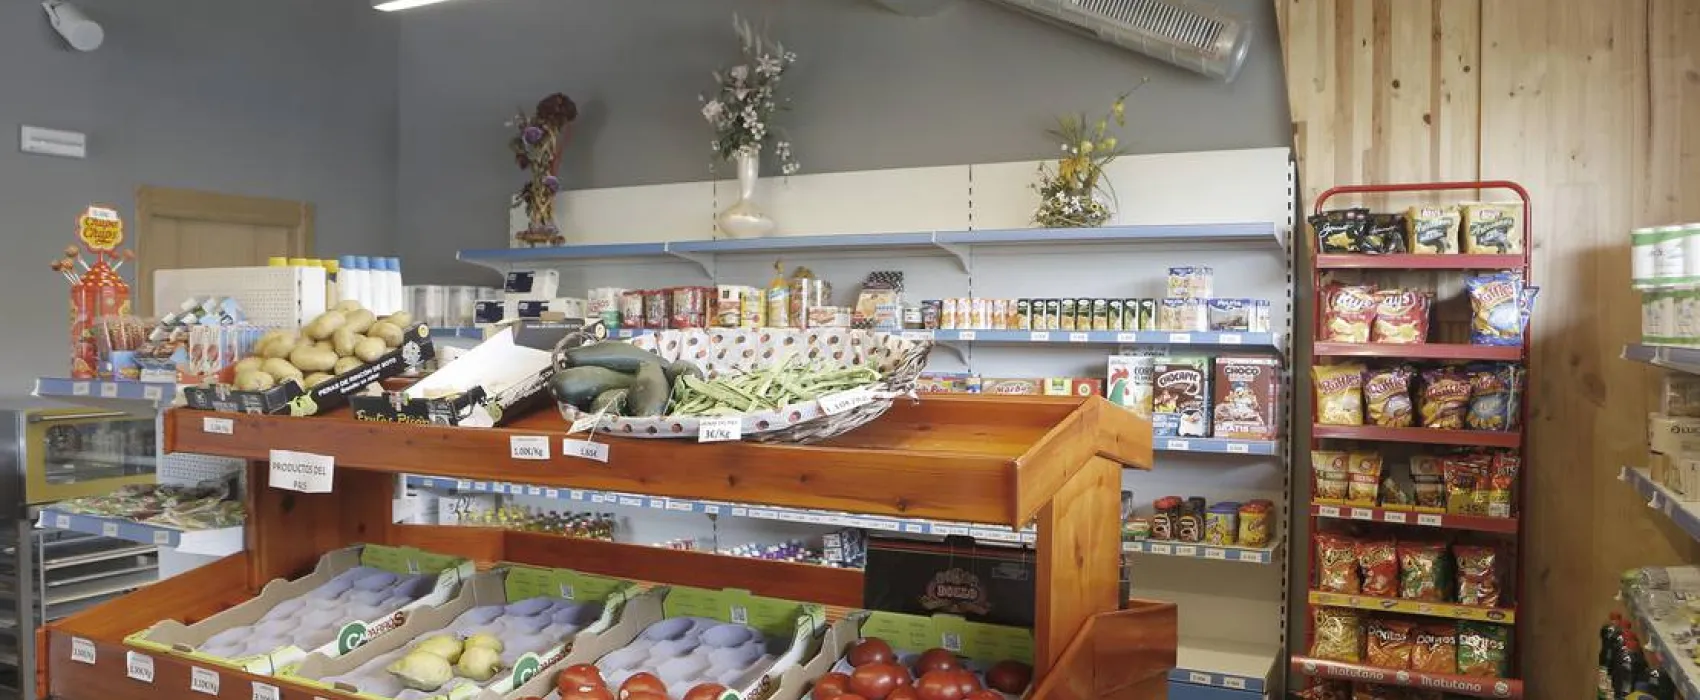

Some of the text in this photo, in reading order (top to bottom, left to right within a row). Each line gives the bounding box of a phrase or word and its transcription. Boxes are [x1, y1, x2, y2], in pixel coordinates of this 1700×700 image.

[1225, 366, 1259, 375] CHOCO
[272, 462, 326, 476] PRODUCTOS DEL
[1328, 665, 1383, 680] Matutano
[1420, 675, 1482, 692] Matutano
